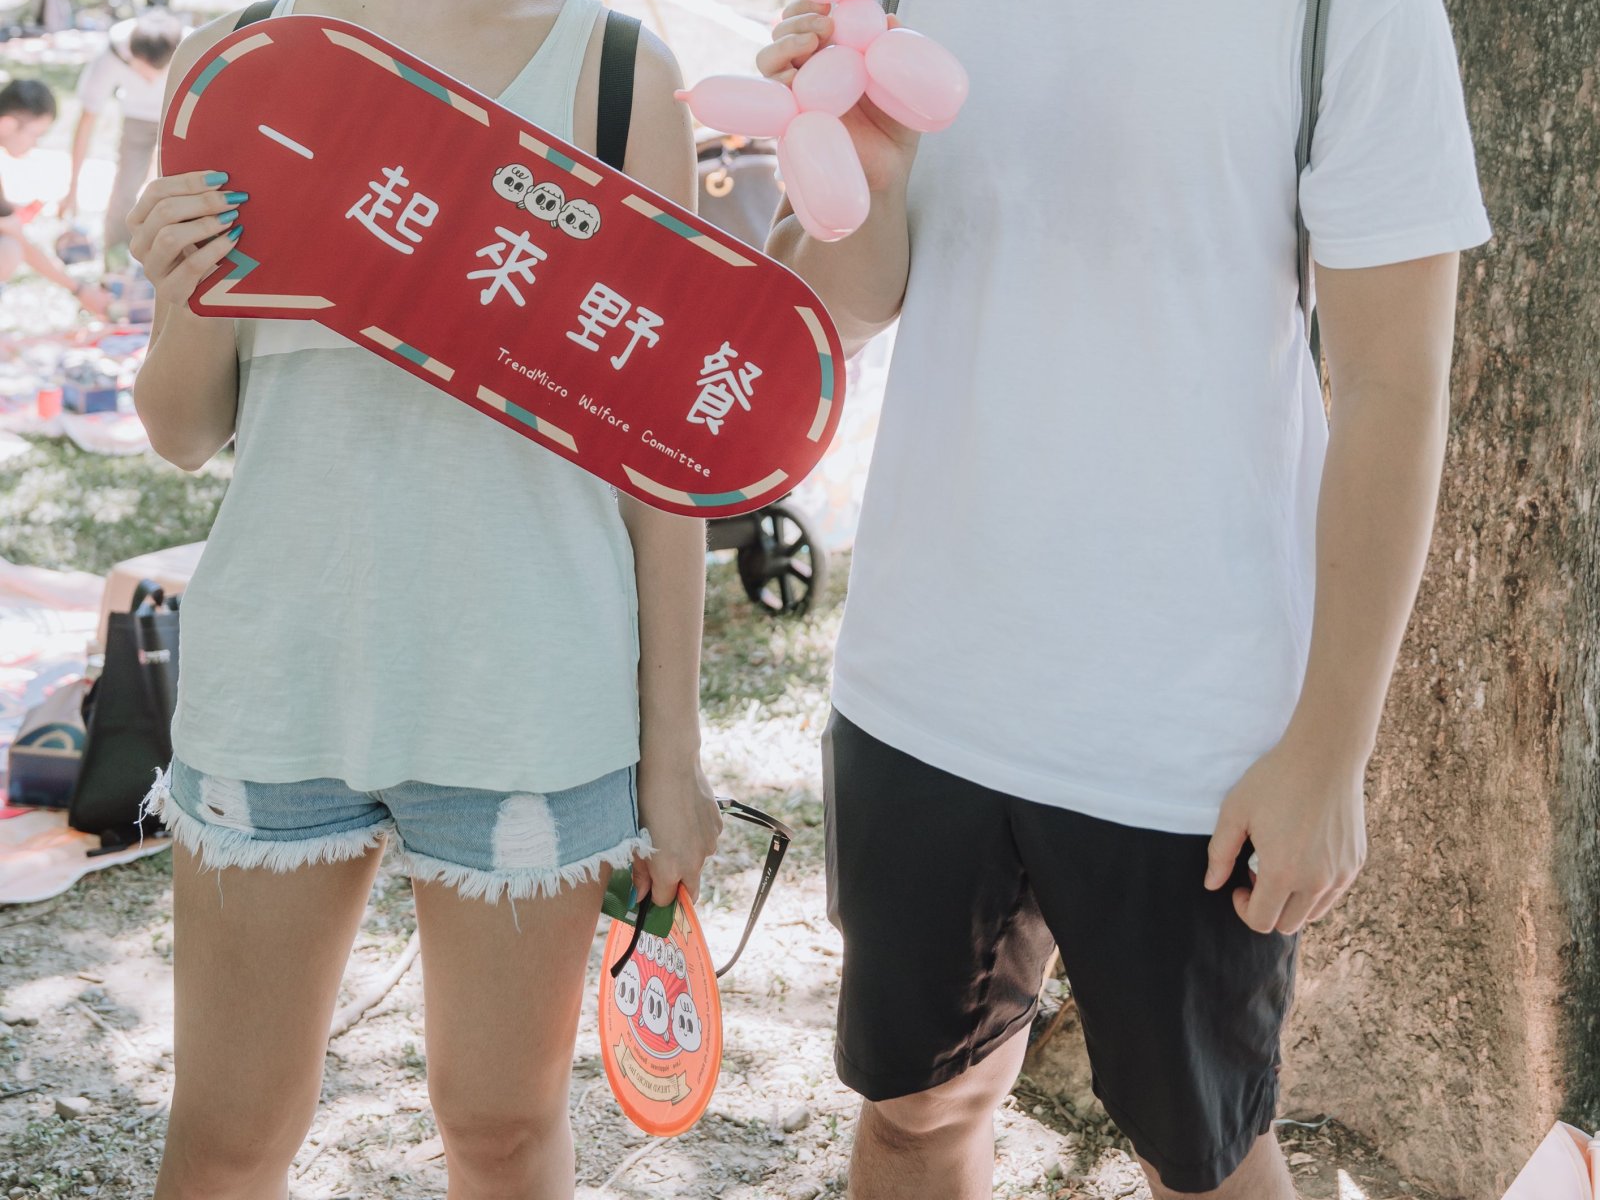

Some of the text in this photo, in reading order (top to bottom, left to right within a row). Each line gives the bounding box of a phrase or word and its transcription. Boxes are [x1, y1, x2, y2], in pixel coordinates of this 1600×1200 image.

[257, 124, 763, 437] 一起來野餐
[496, 346, 712, 478] TrendMicro Welfare Committee
